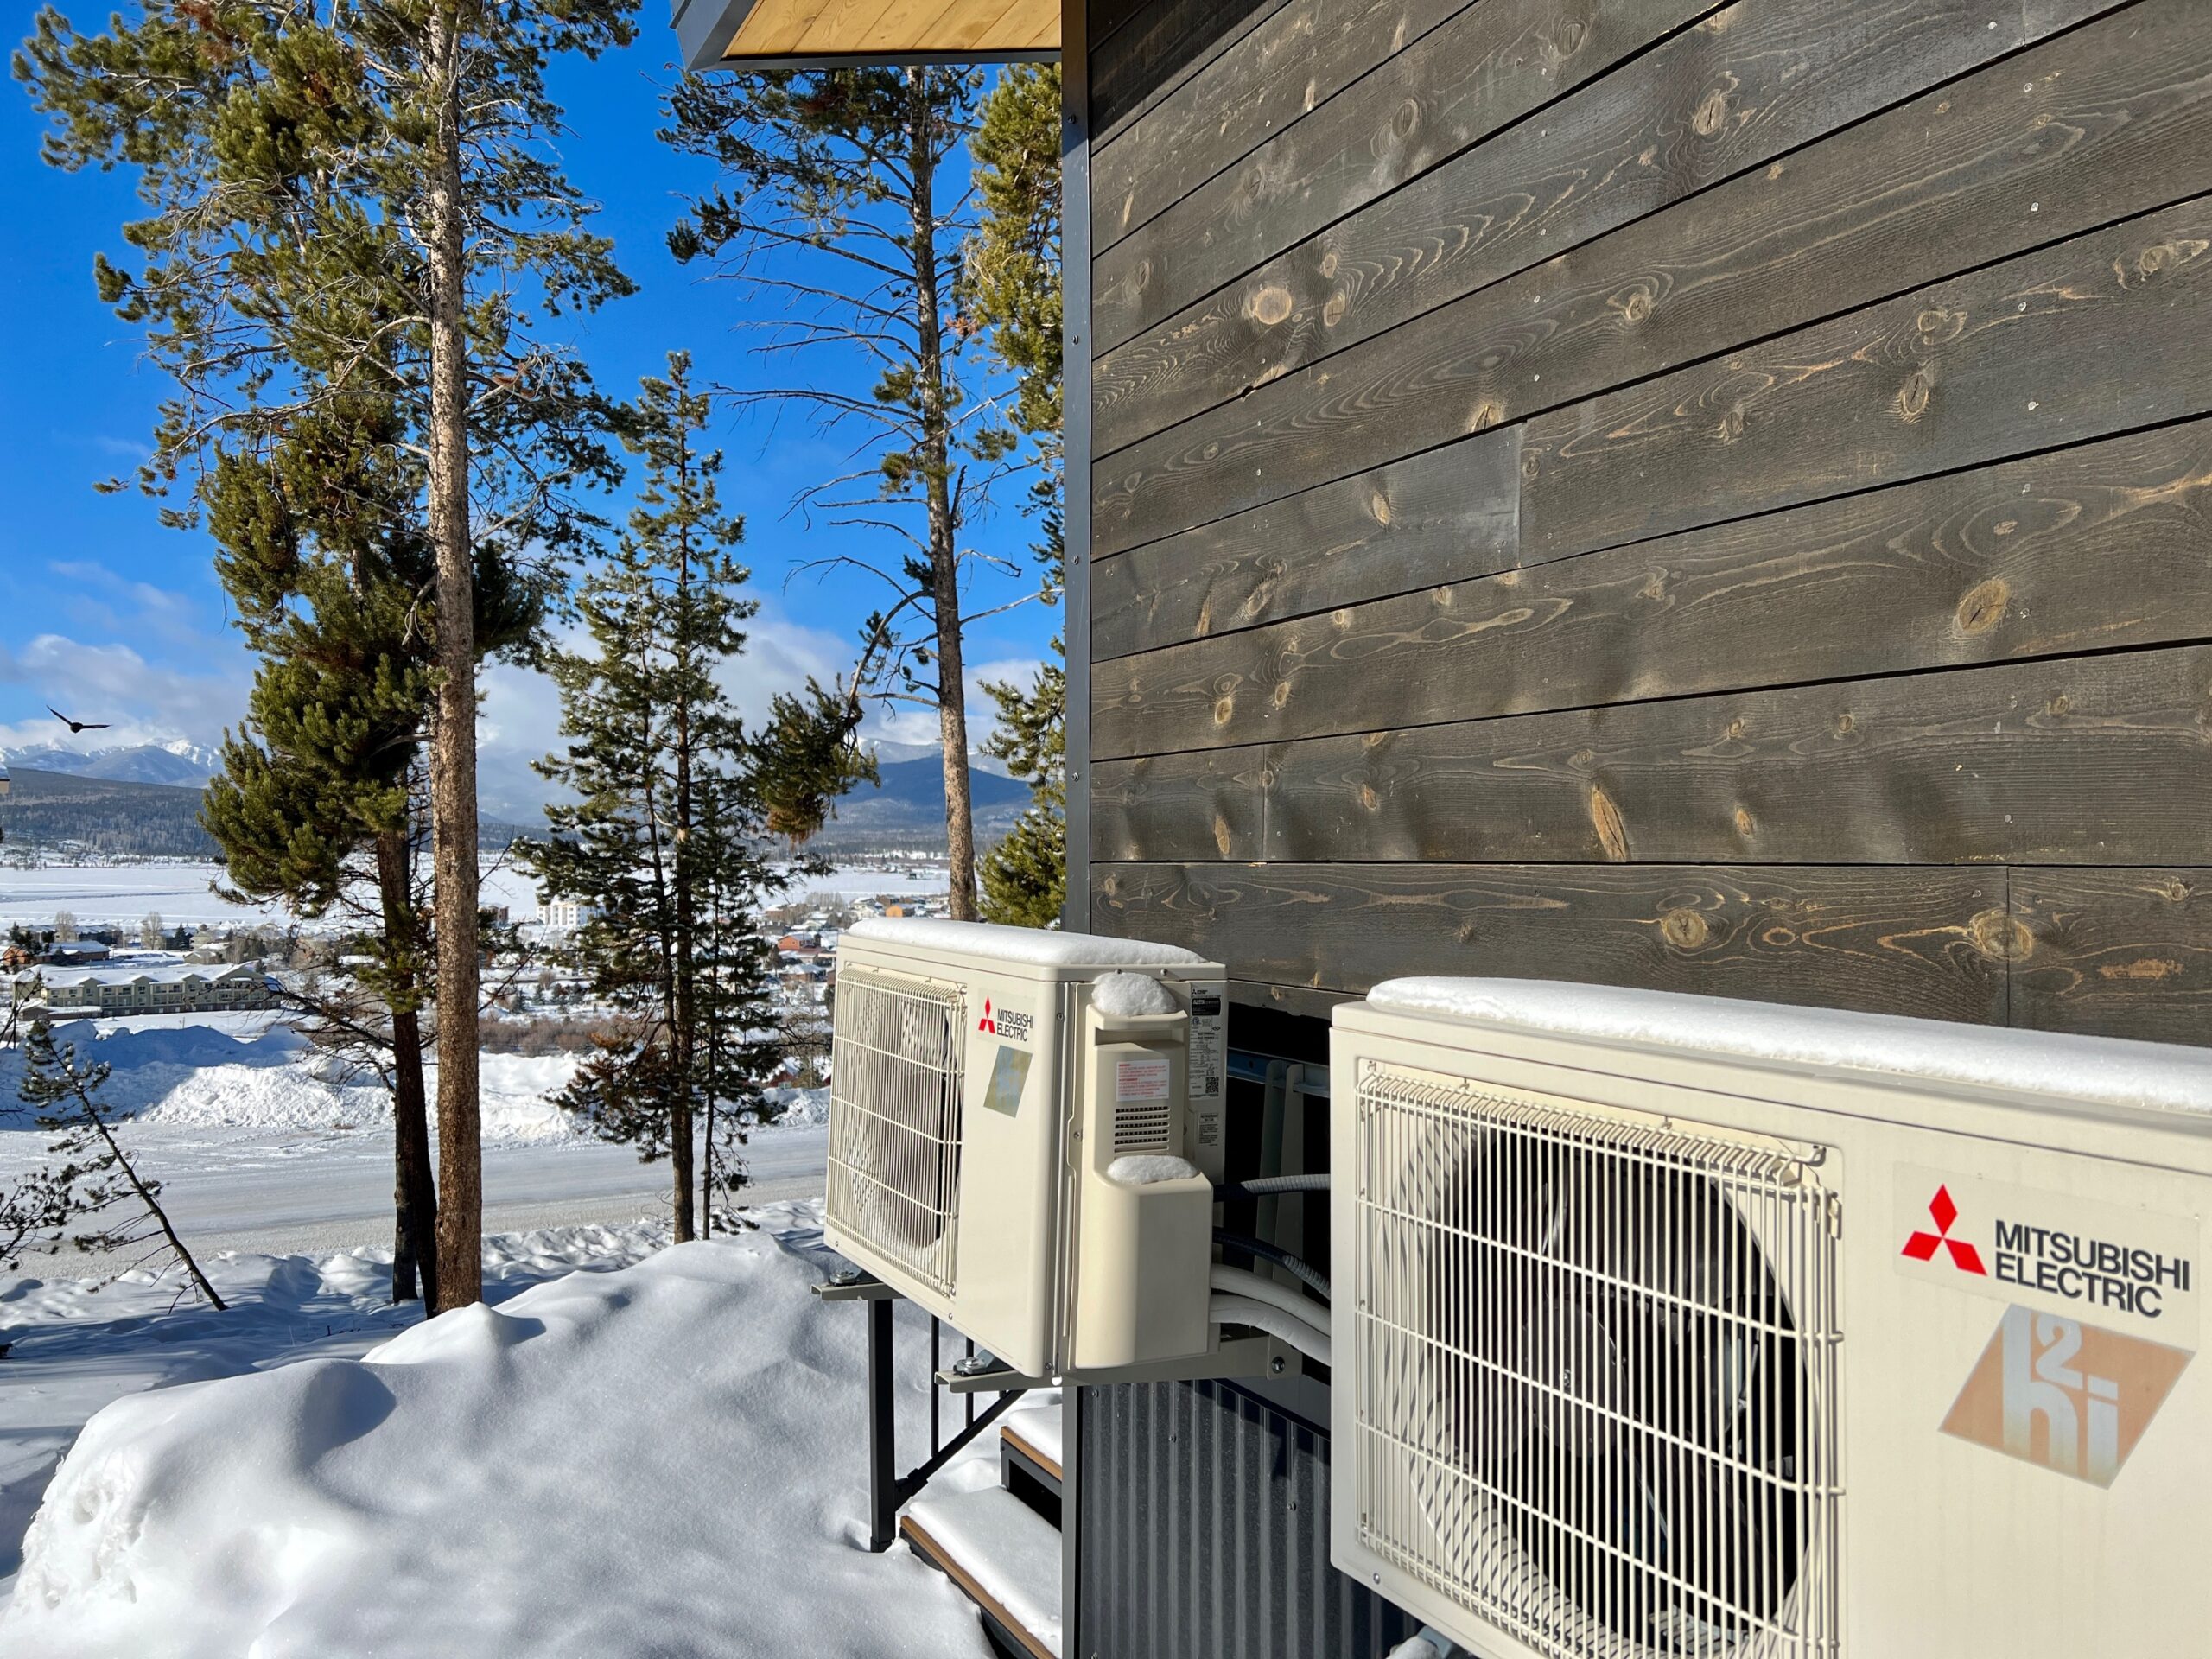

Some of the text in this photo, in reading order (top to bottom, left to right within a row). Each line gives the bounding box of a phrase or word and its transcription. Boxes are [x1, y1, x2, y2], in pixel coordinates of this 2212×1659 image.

[997, 1008, 1033, 1028] MITSUBISHI
[997, 1023, 1027, 1041] ELECTRIC
[1995, 1219, 2190, 1292] MITSUBISHI
[1995, 1251, 2163, 1319] ELECTRIC
